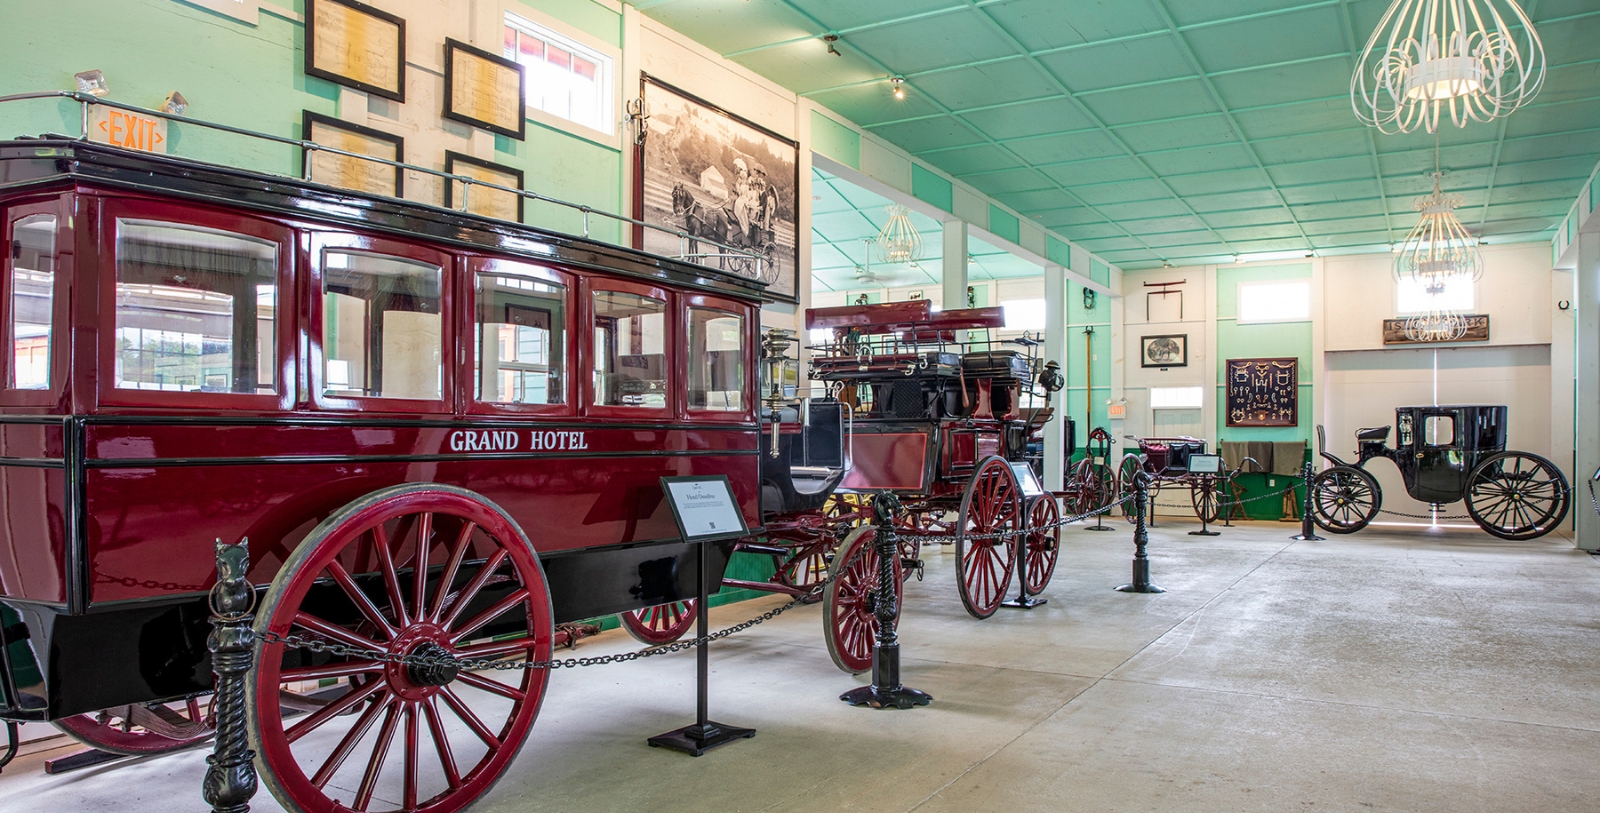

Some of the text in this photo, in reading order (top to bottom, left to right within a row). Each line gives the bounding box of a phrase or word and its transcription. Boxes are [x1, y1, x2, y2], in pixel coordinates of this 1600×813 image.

[109, 110, 157, 151] EXIT
[450, 430, 588, 452] GRAND HOTEL
